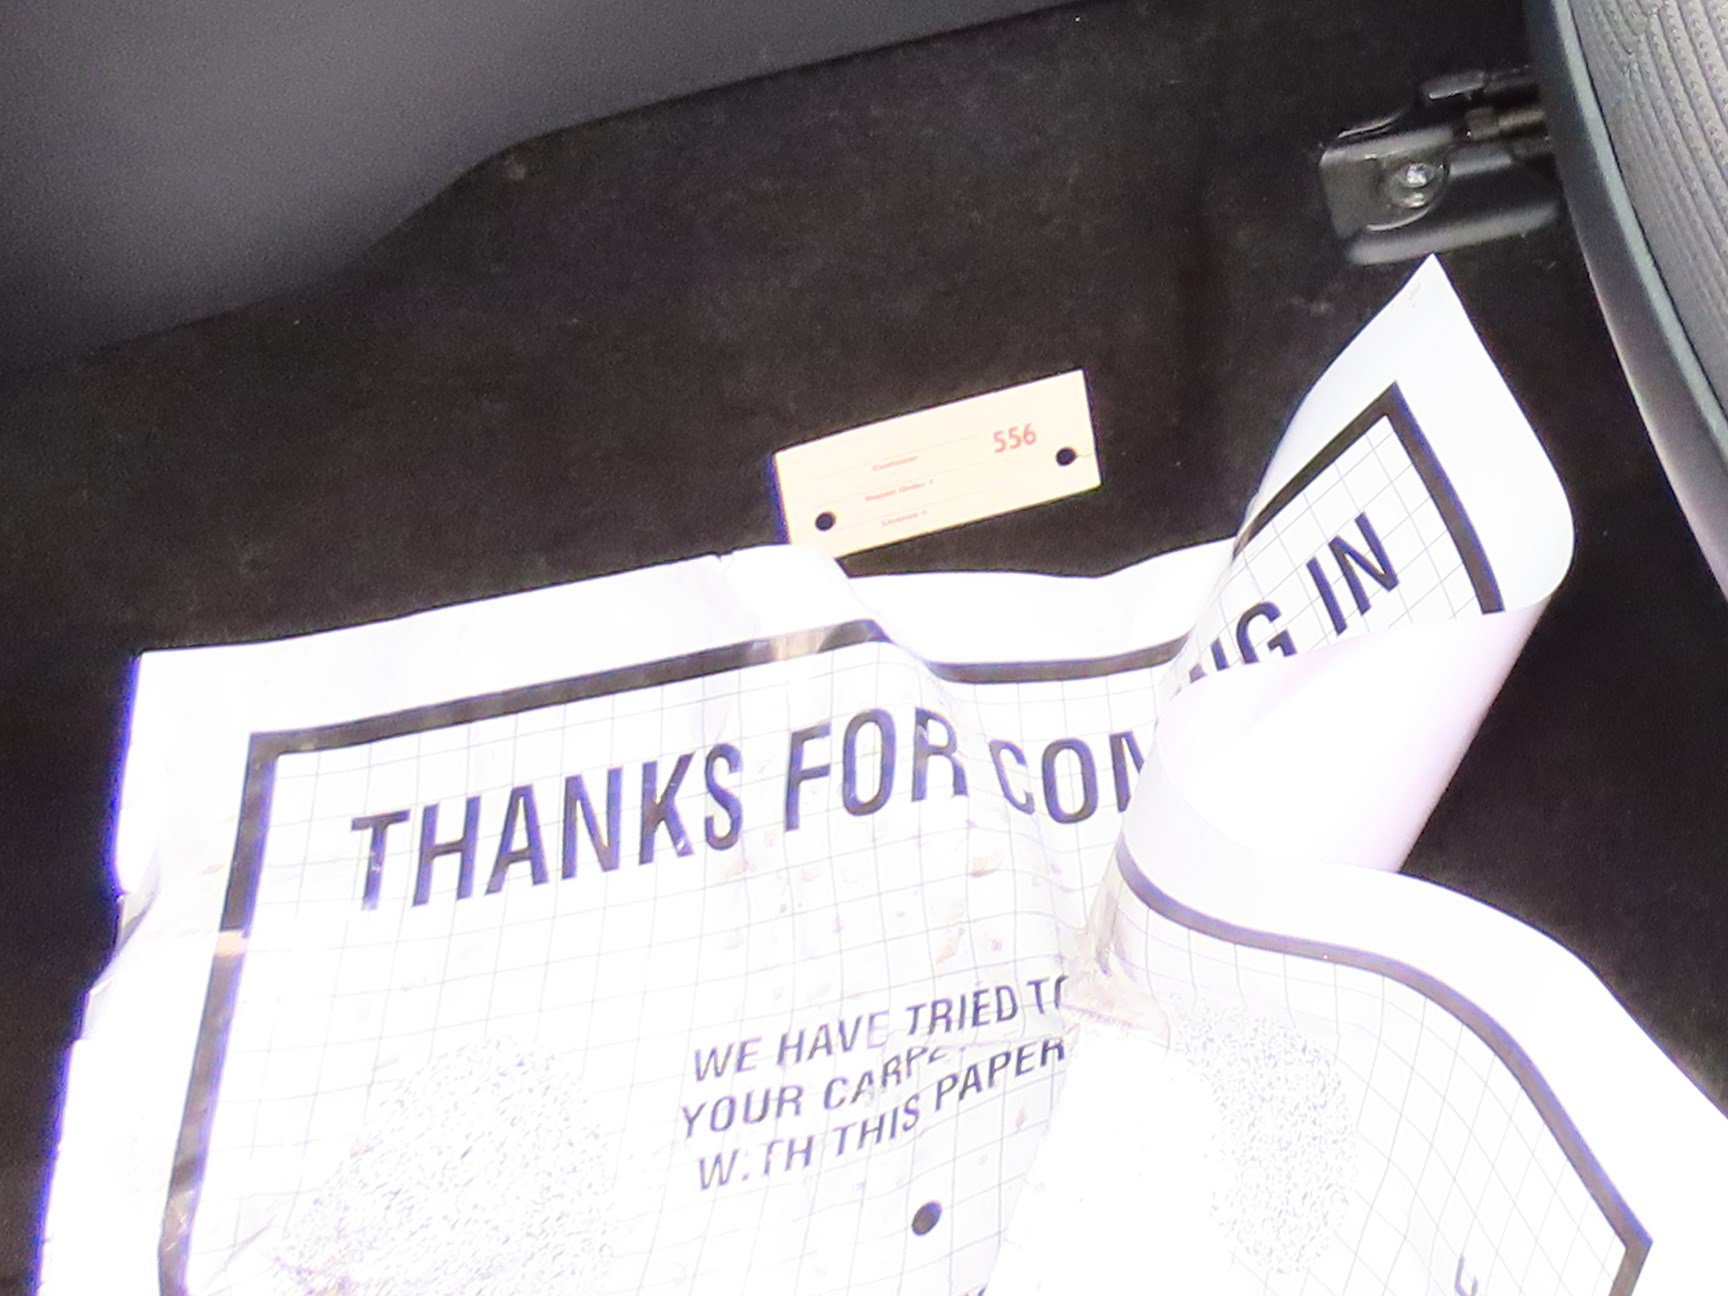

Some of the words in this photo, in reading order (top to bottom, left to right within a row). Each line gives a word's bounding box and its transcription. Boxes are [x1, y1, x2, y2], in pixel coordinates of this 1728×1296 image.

[993, 422, 1037, 454] 556
[1306, 512, 1399, 636] IN
[351, 742, 745, 911] THANKS
[784, 706, 971, 833] FOR
[693, 1036, 763, 1083] WE
[776, 1008, 890, 1068] HAVE
[906, 984, 1019, 1037] TRIED
[681, 1083, 803, 1139] YOUR
[834, 1093, 922, 1158] THIS
[934, 1035, 1066, 1113] PAPER
